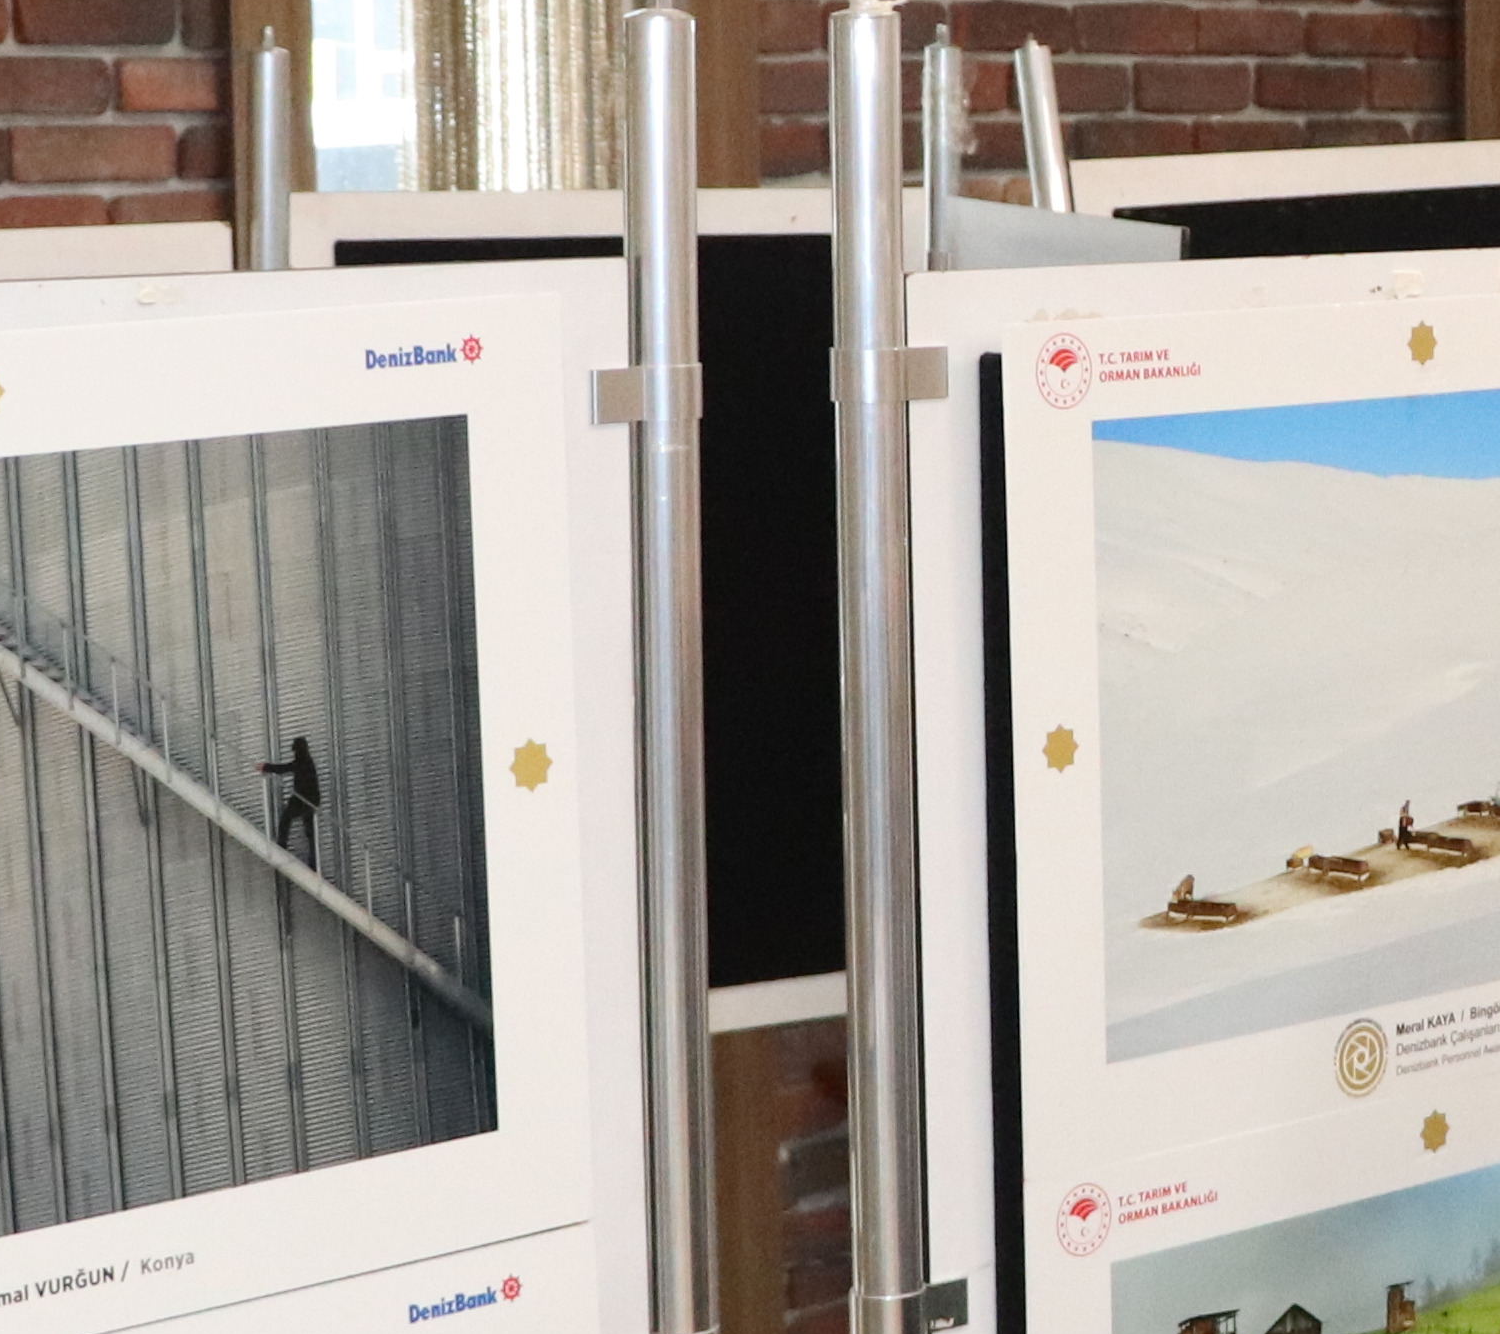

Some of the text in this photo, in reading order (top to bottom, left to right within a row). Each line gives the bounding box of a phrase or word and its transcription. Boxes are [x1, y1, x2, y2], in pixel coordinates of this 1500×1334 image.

[365, 343, 457, 370] DenizBank
[1119, 350, 1154, 363] TARIM
[1156, 349, 1170, 361] VE
[1099, 361, 1202, 383] ORMAN BAKANLIĞI
[1396, 1019, 1425, 1036] Meral
[1427, 1012, 1456, 1028] KAYA
[1396, 1035, 1448, 1056] Denizbank
[1138, 1185, 1172, 1203] TARIM
[1174, 1181, 1188, 1194] VE
[1118, 1189, 1219, 1224] ORMAN BAKANLIĞI
[35, 1264, 116, 1299] VURĞUN
[120, 1260, 131, 1283] /
[140, 1250, 196, 1276] Konya
[409, 1286, 498, 1324] DenizBank
